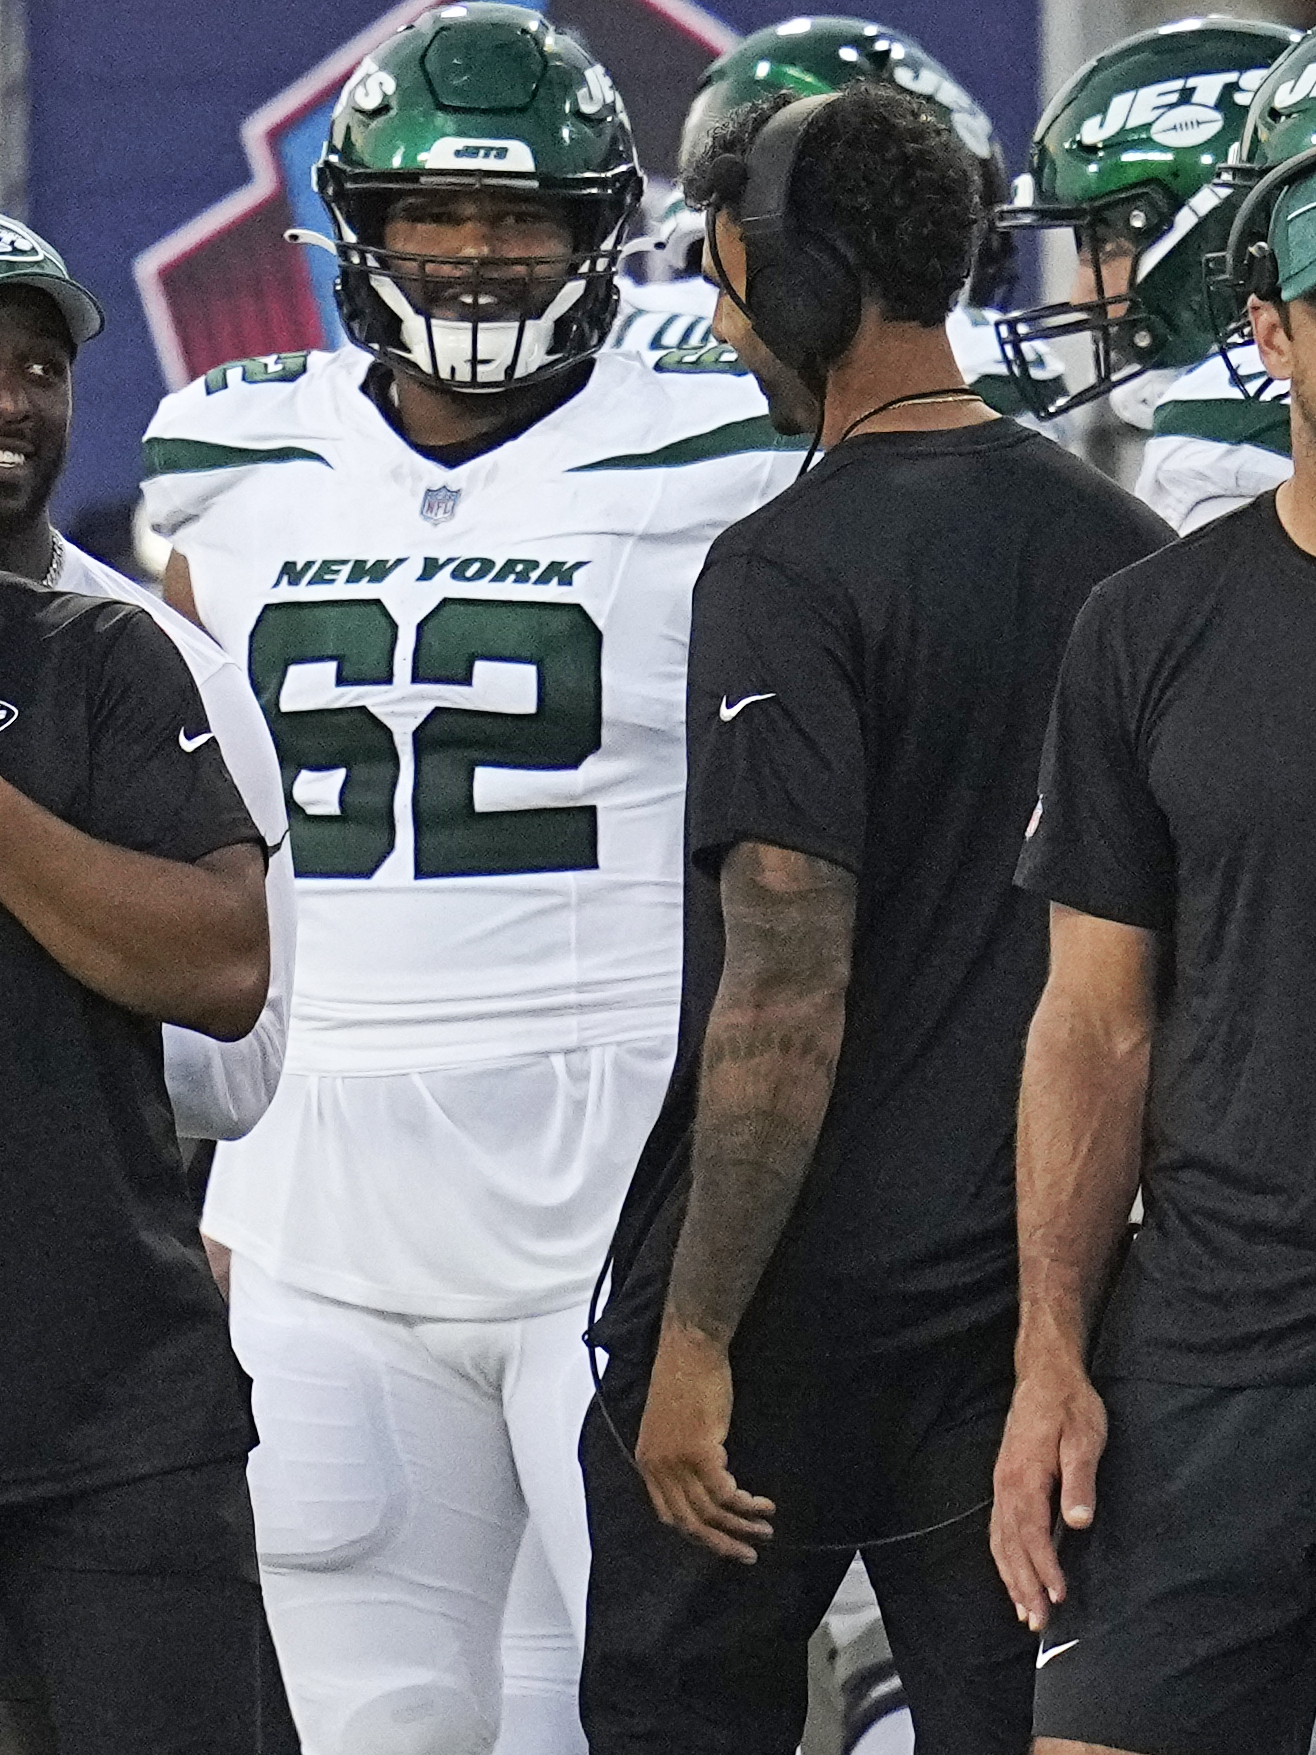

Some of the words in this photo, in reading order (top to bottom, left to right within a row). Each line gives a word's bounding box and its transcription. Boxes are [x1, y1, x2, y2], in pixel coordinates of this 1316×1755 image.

[271, 556, 411, 590] NEW
[415, 556, 593, 587] YORK
[247, 597, 604, 880] 62
